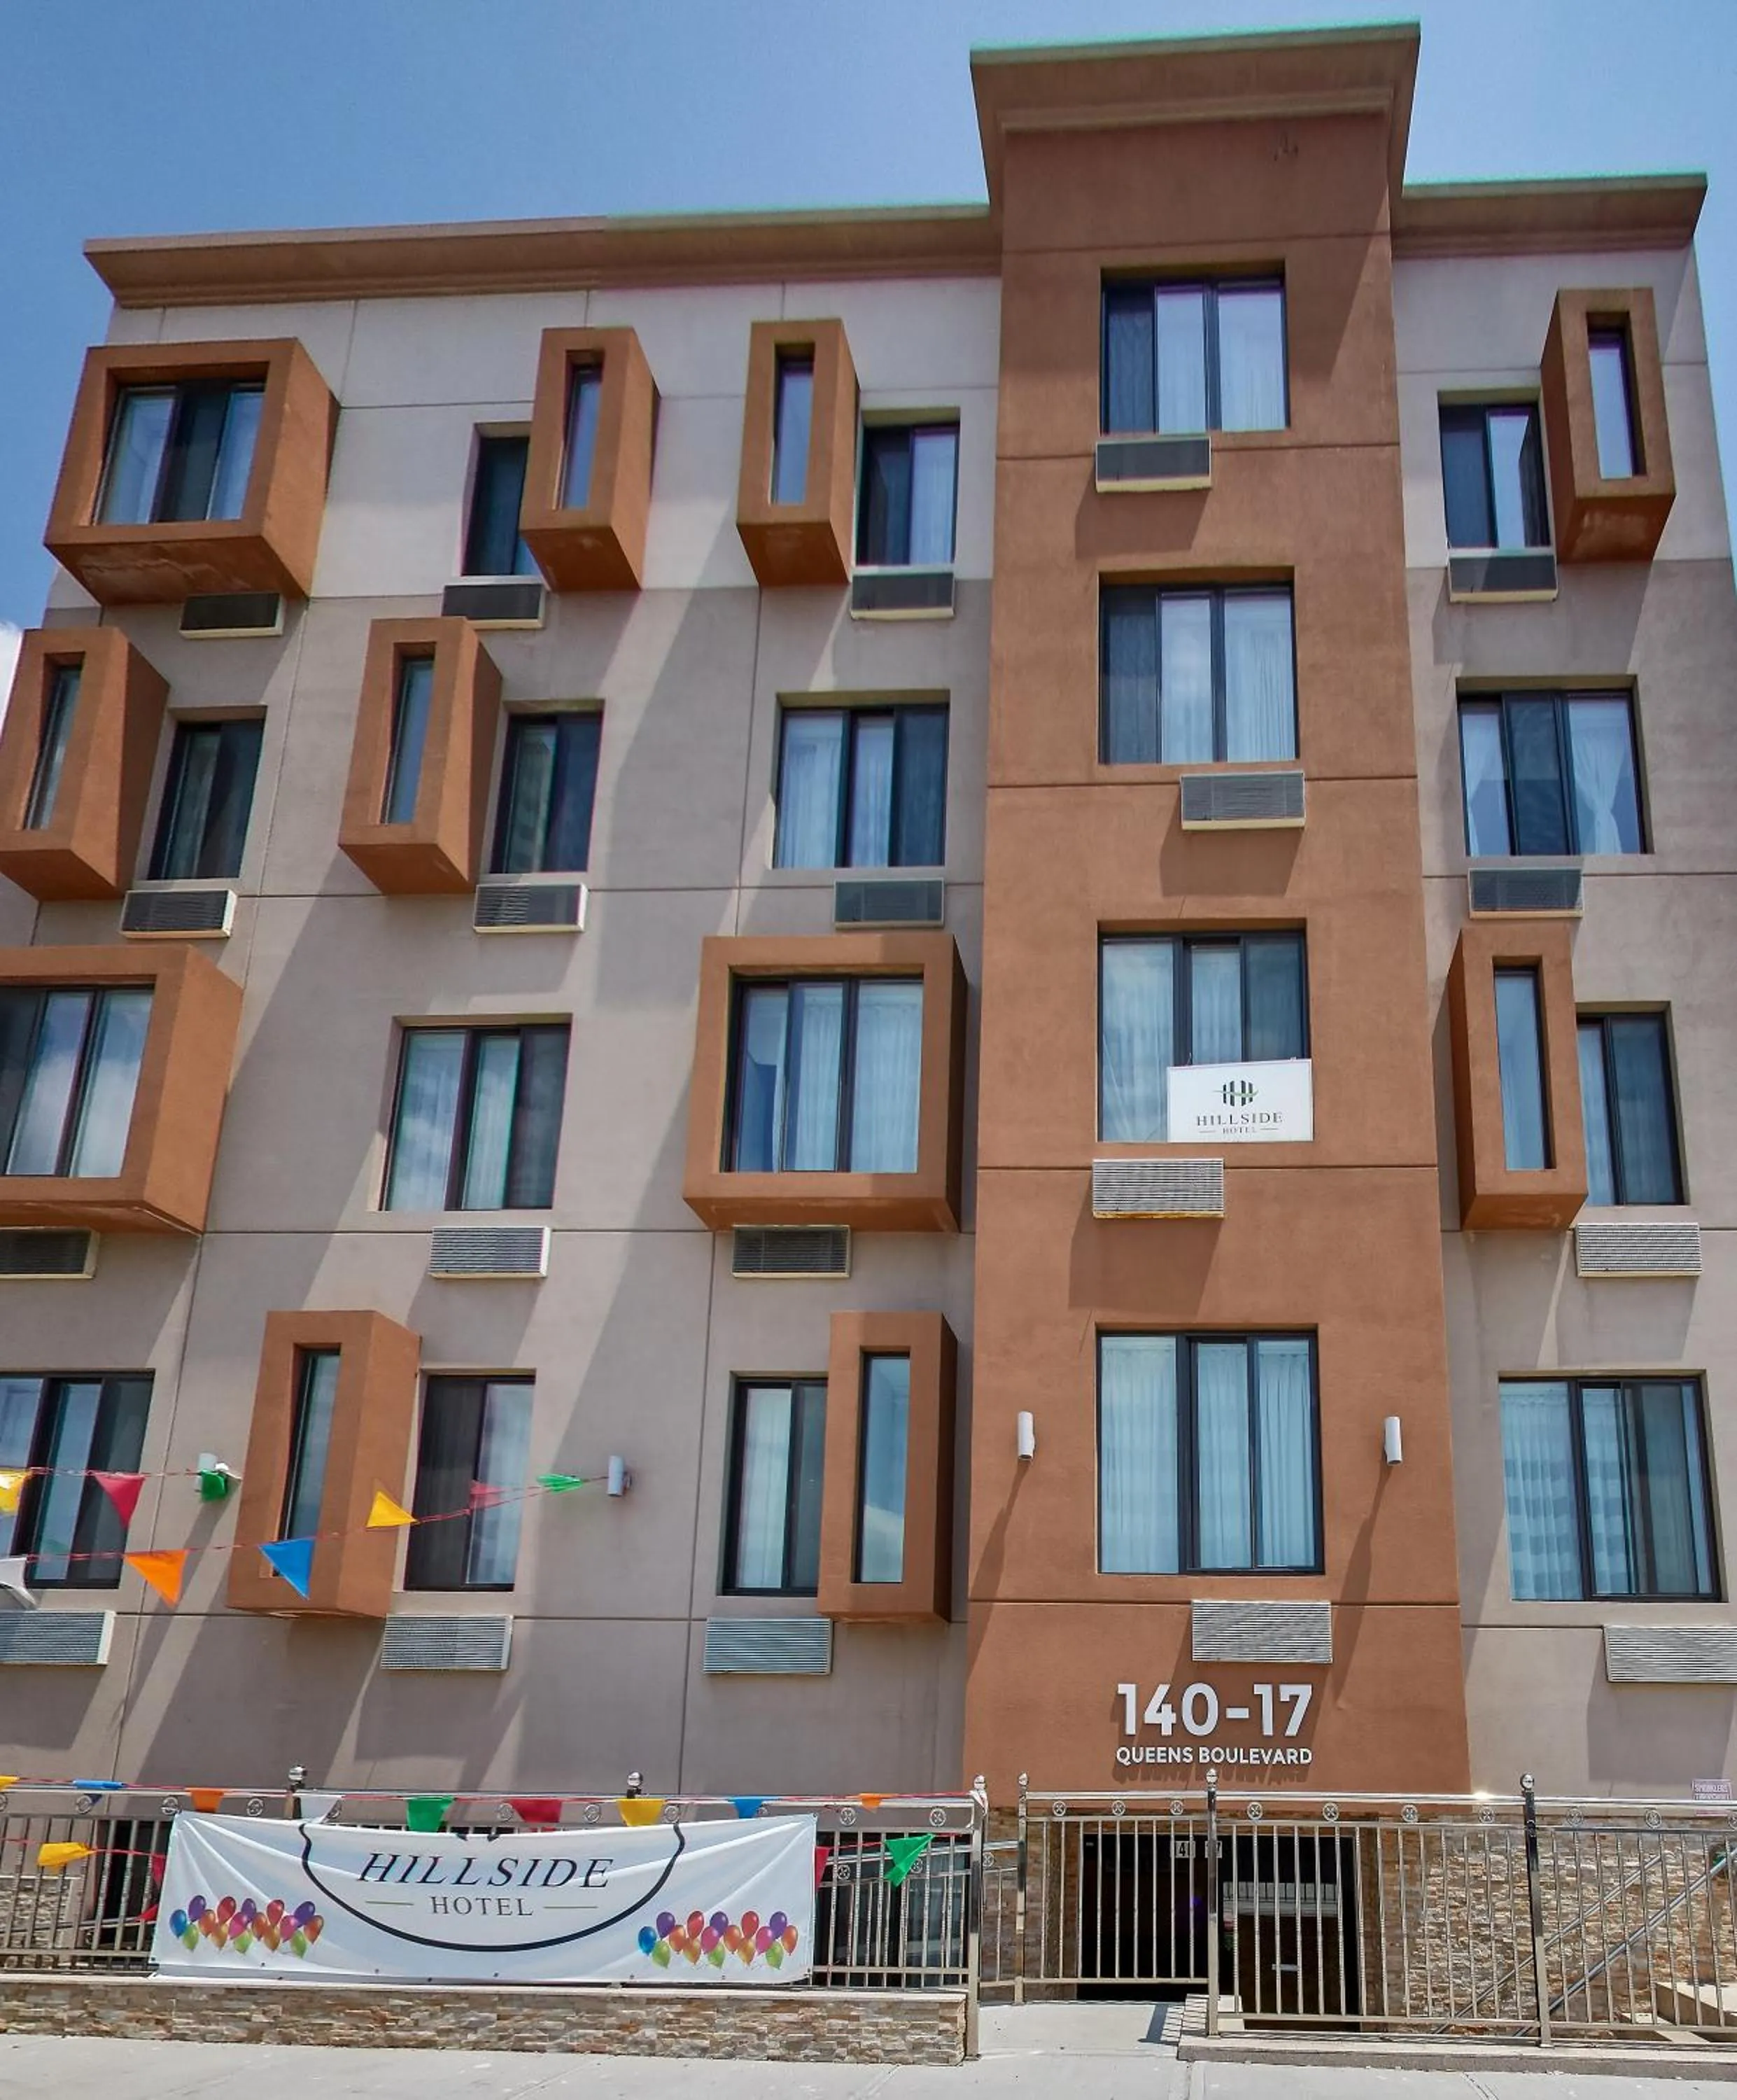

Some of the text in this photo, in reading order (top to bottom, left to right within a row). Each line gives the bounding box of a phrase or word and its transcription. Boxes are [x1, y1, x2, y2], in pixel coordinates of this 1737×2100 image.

[1197, 1112, 1283, 1126] HILLSIDE
[1118, 1683, 1312, 1736] 140-17
[1116, 1747, 1311, 1765] QUEENS BOULEVARD
[357, 1853, 613, 1888] HILLSIDE
[432, 1896, 533, 1916] HOTEL
